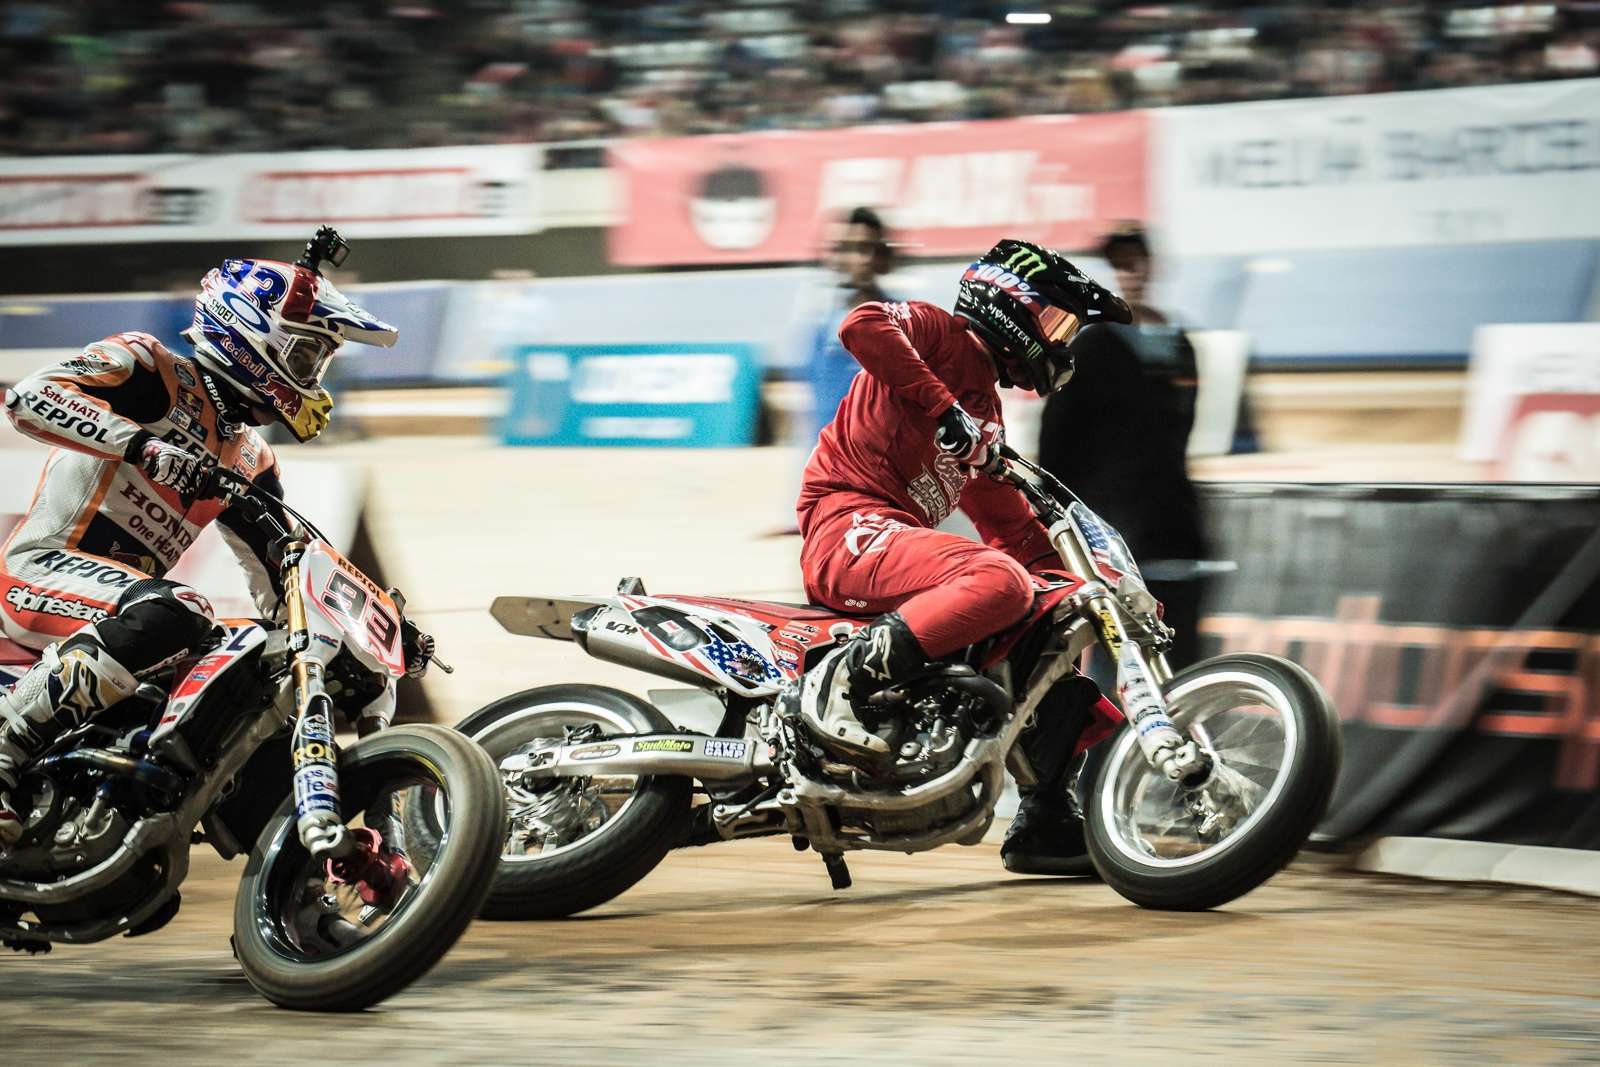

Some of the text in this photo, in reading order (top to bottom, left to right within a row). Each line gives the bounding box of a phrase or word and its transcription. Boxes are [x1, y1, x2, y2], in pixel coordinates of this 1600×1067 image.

[972, 263, 1040, 305] 100%
[210, 298, 234, 322] SHOEI
[986, 302, 1032, 346] MONSTER
[39, 385, 68, 405] Satu
[202, 374, 229, 416] REPSOL
[20, 390, 109, 444] REPSOL
[128, 514, 155, 541] One
[6, 584, 109, 624] alpinestars
[322, 567, 401, 657] 93
[705, 740, 746, 750] NOYES
[705, 749, 744, 759] CAMP
